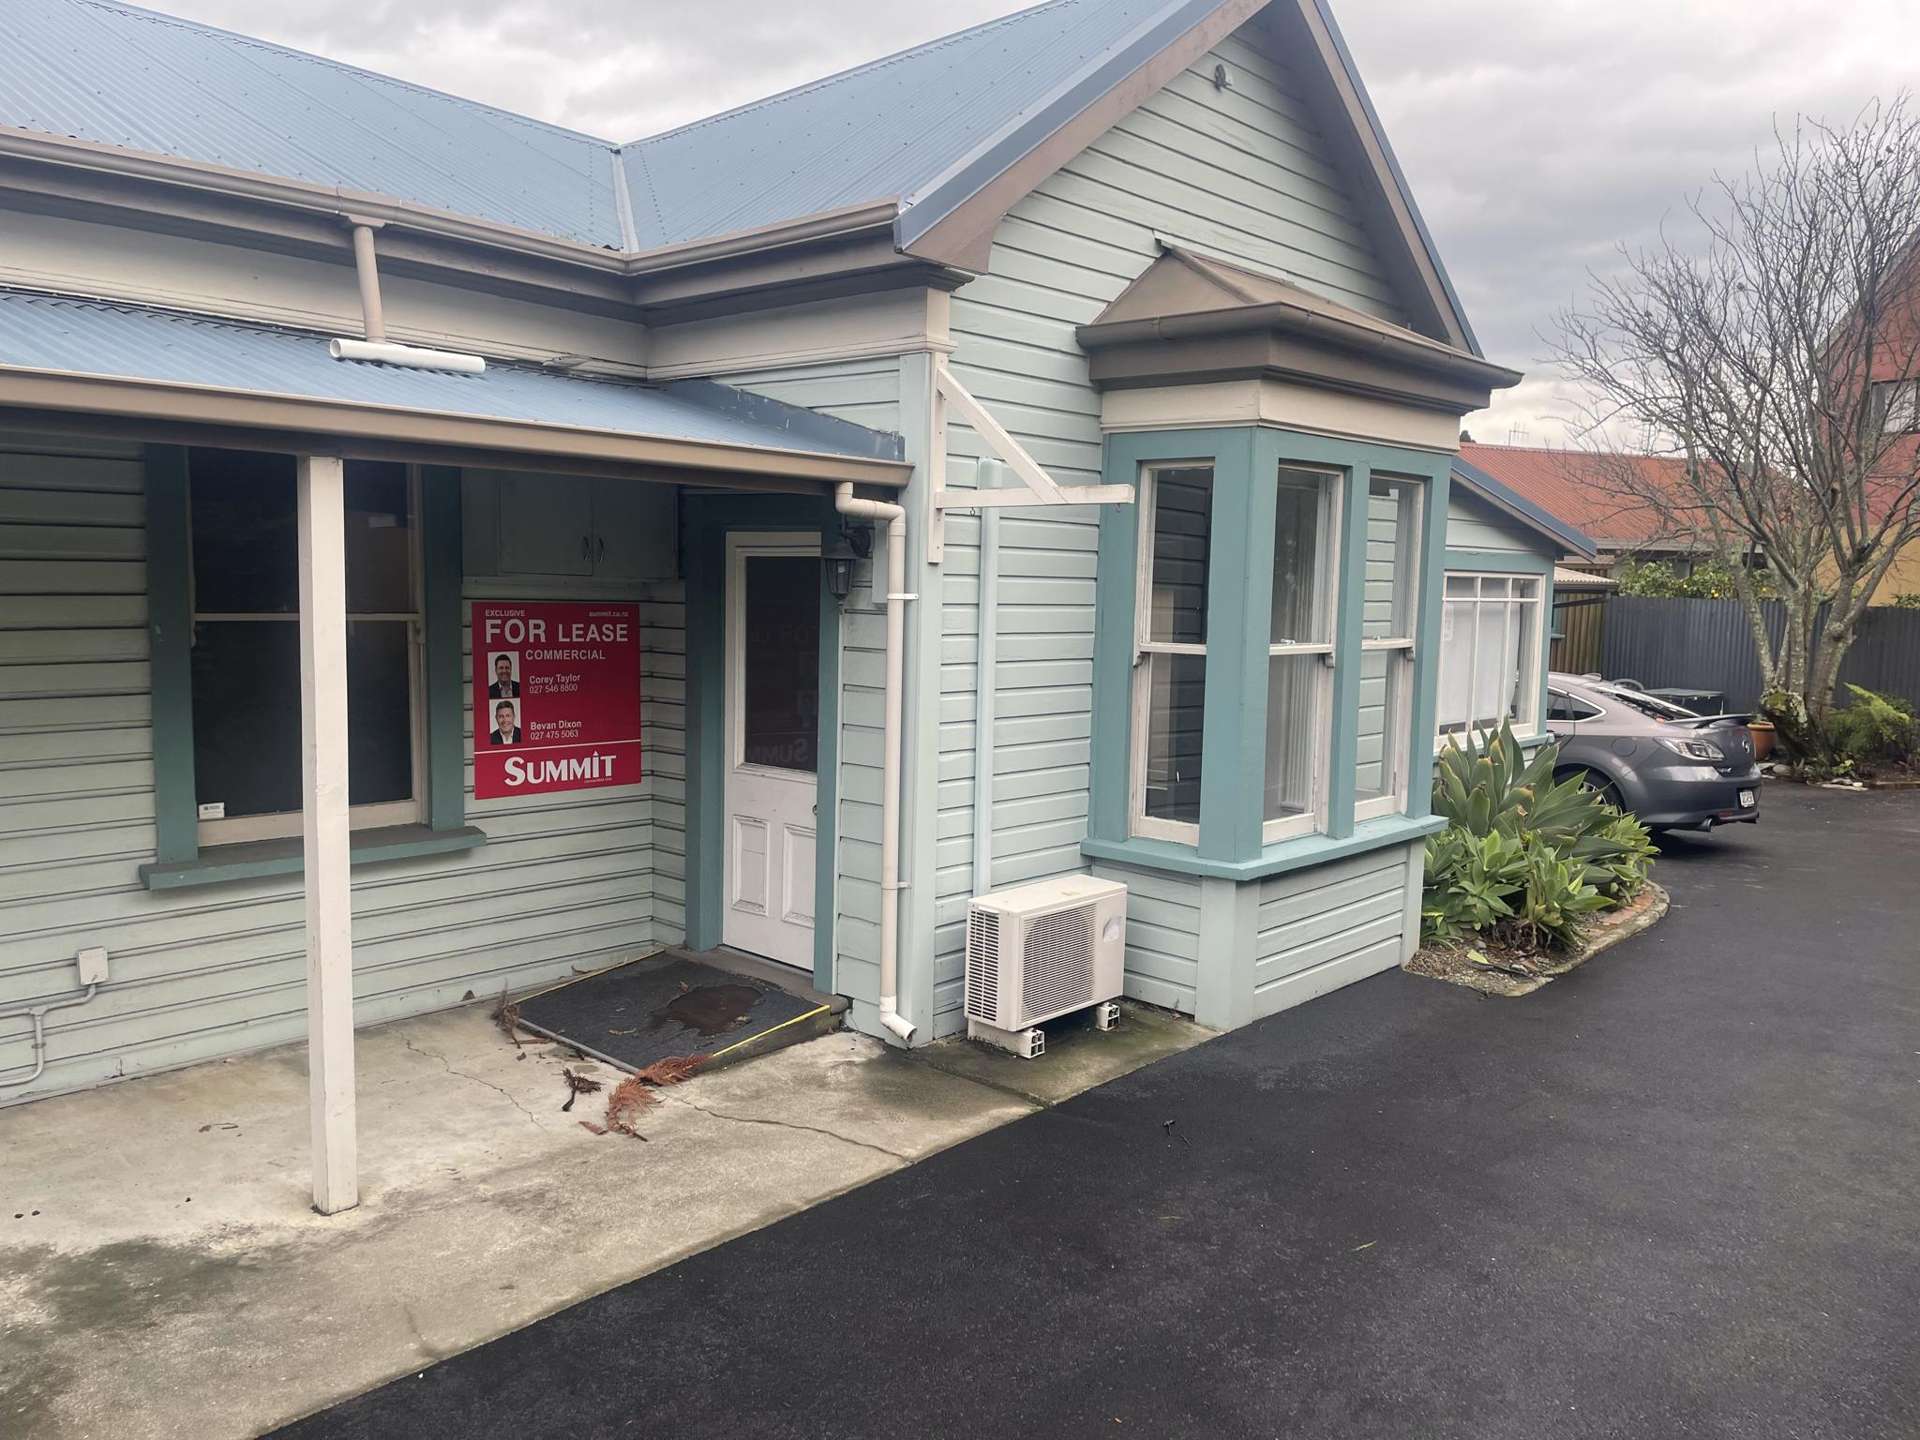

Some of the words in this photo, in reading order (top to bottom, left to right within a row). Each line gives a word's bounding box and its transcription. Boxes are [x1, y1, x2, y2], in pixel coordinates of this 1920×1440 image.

[485, 609, 526, 617] EXCLUSIVE
[485, 618, 547, 643] FOR
[558, 623, 629, 642] LEASE
[525, 650, 606, 660] COMMERCIAL
[529, 675, 554, 685] Corey
[555, 673, 581, 683] Taylor
[529, 685, 543, 694] 027
[530, 721, 556, 730] Bevan
[558, 720, 582, 729] Dixon
[530, 731, 544, 741] 027
[504, 750, 617, 786] SUMMIT
